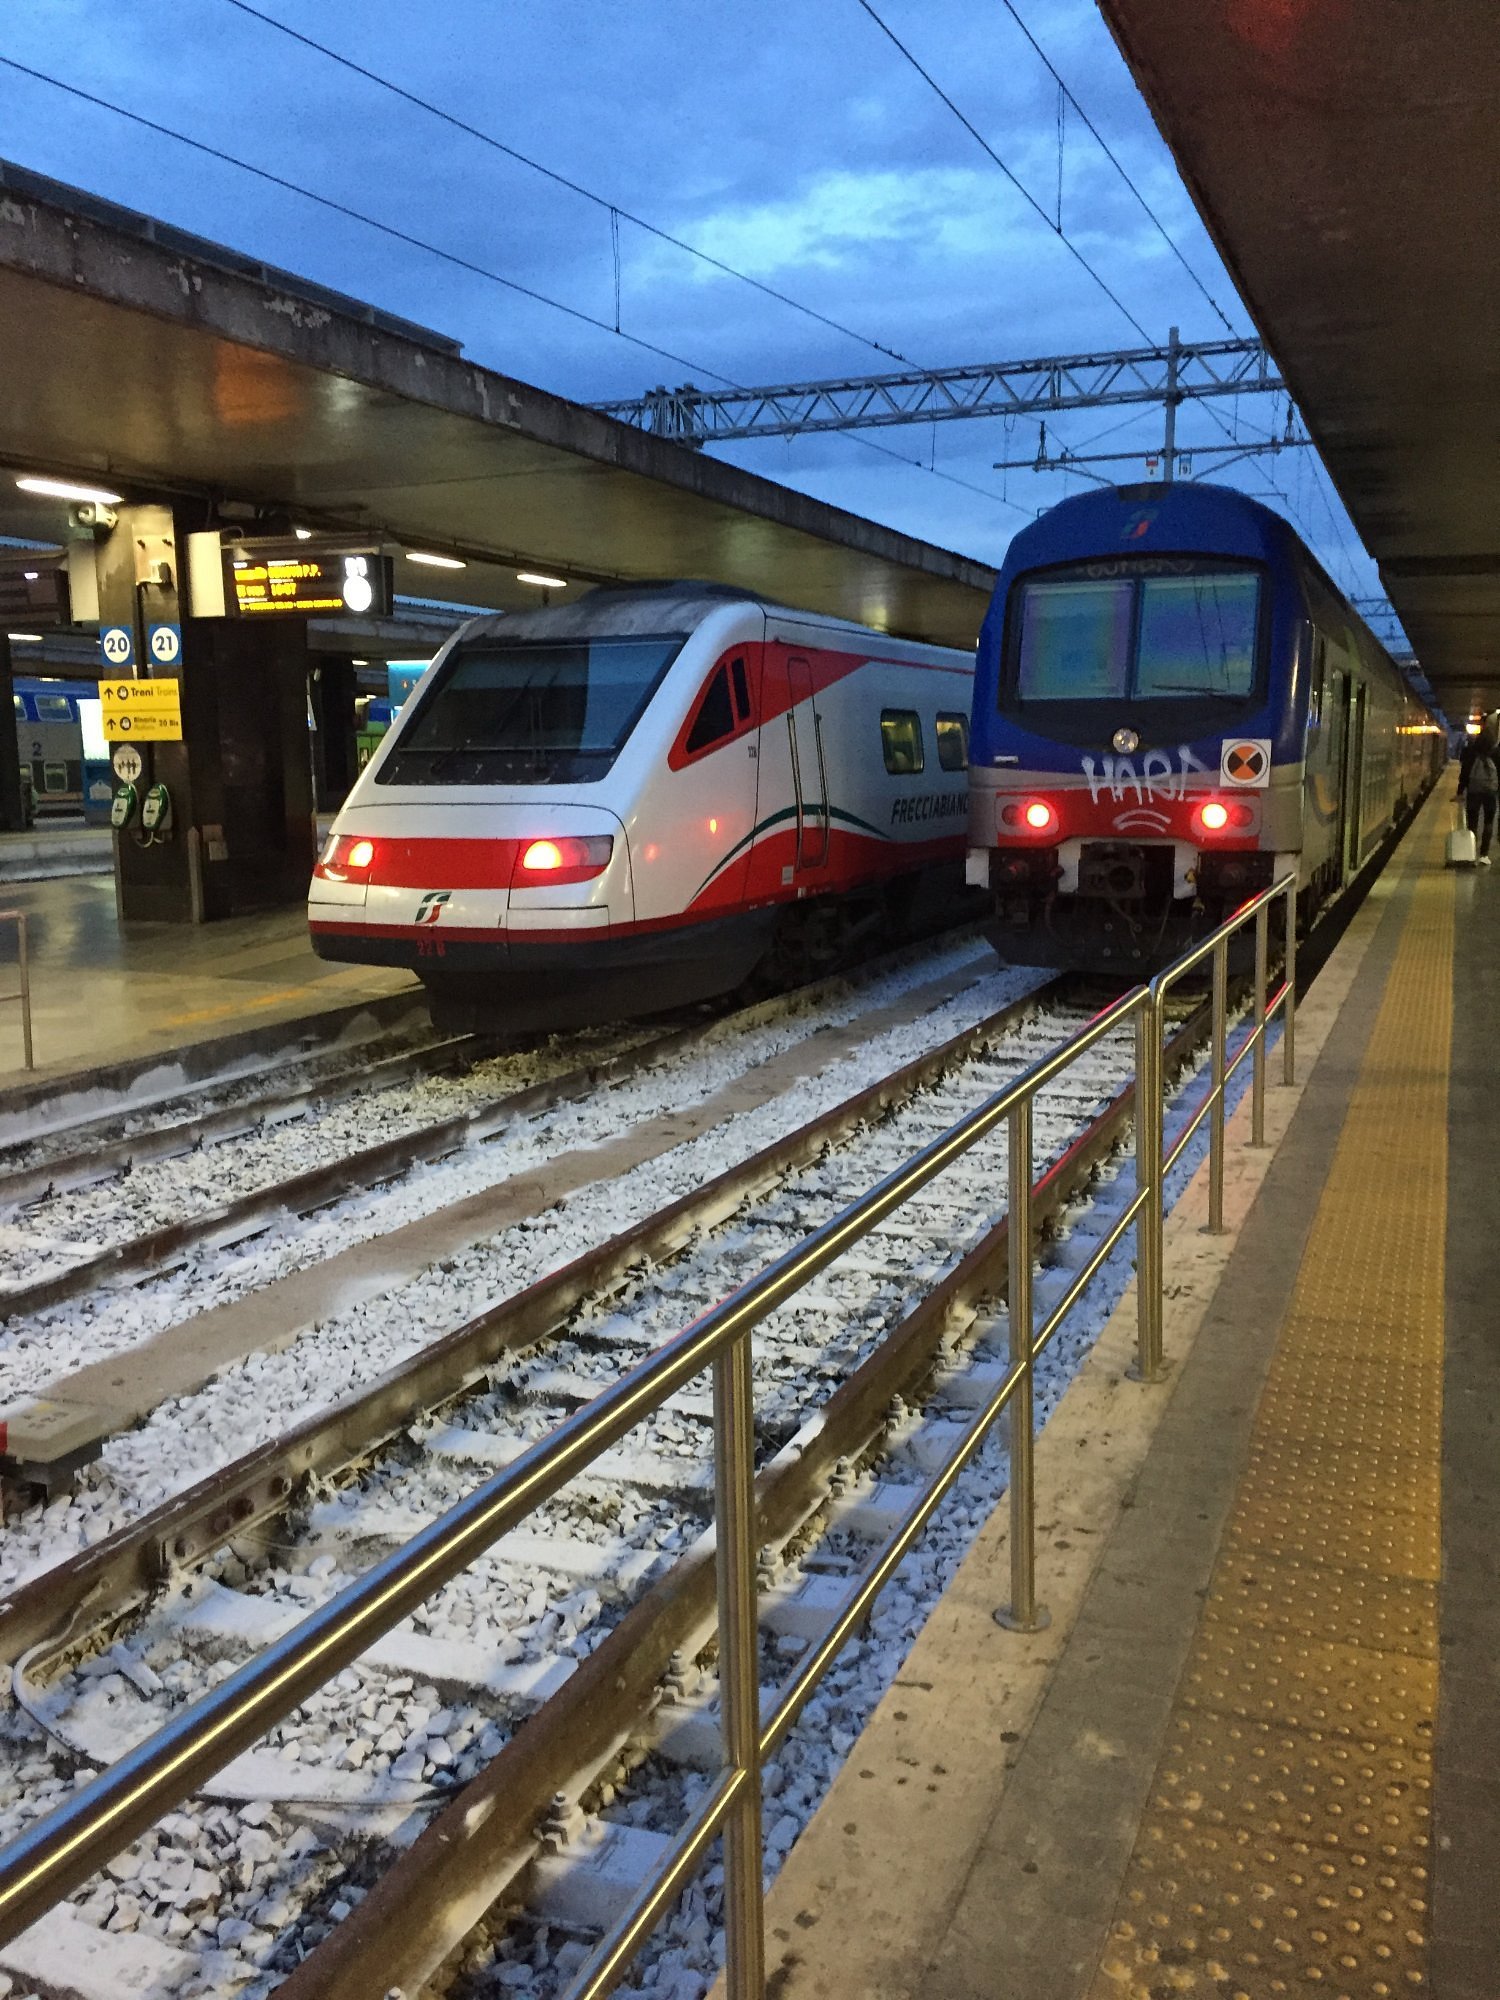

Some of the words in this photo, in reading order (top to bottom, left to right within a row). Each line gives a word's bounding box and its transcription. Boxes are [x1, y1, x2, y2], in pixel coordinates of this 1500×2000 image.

[106, 637, 128, 653] 20
[155, 635, 173, 651] 21
[131, 686, 154, 697] Treni
[32, 742, 42, 757] 2
[890, 792, 969, 825] FRECCIABIANC
